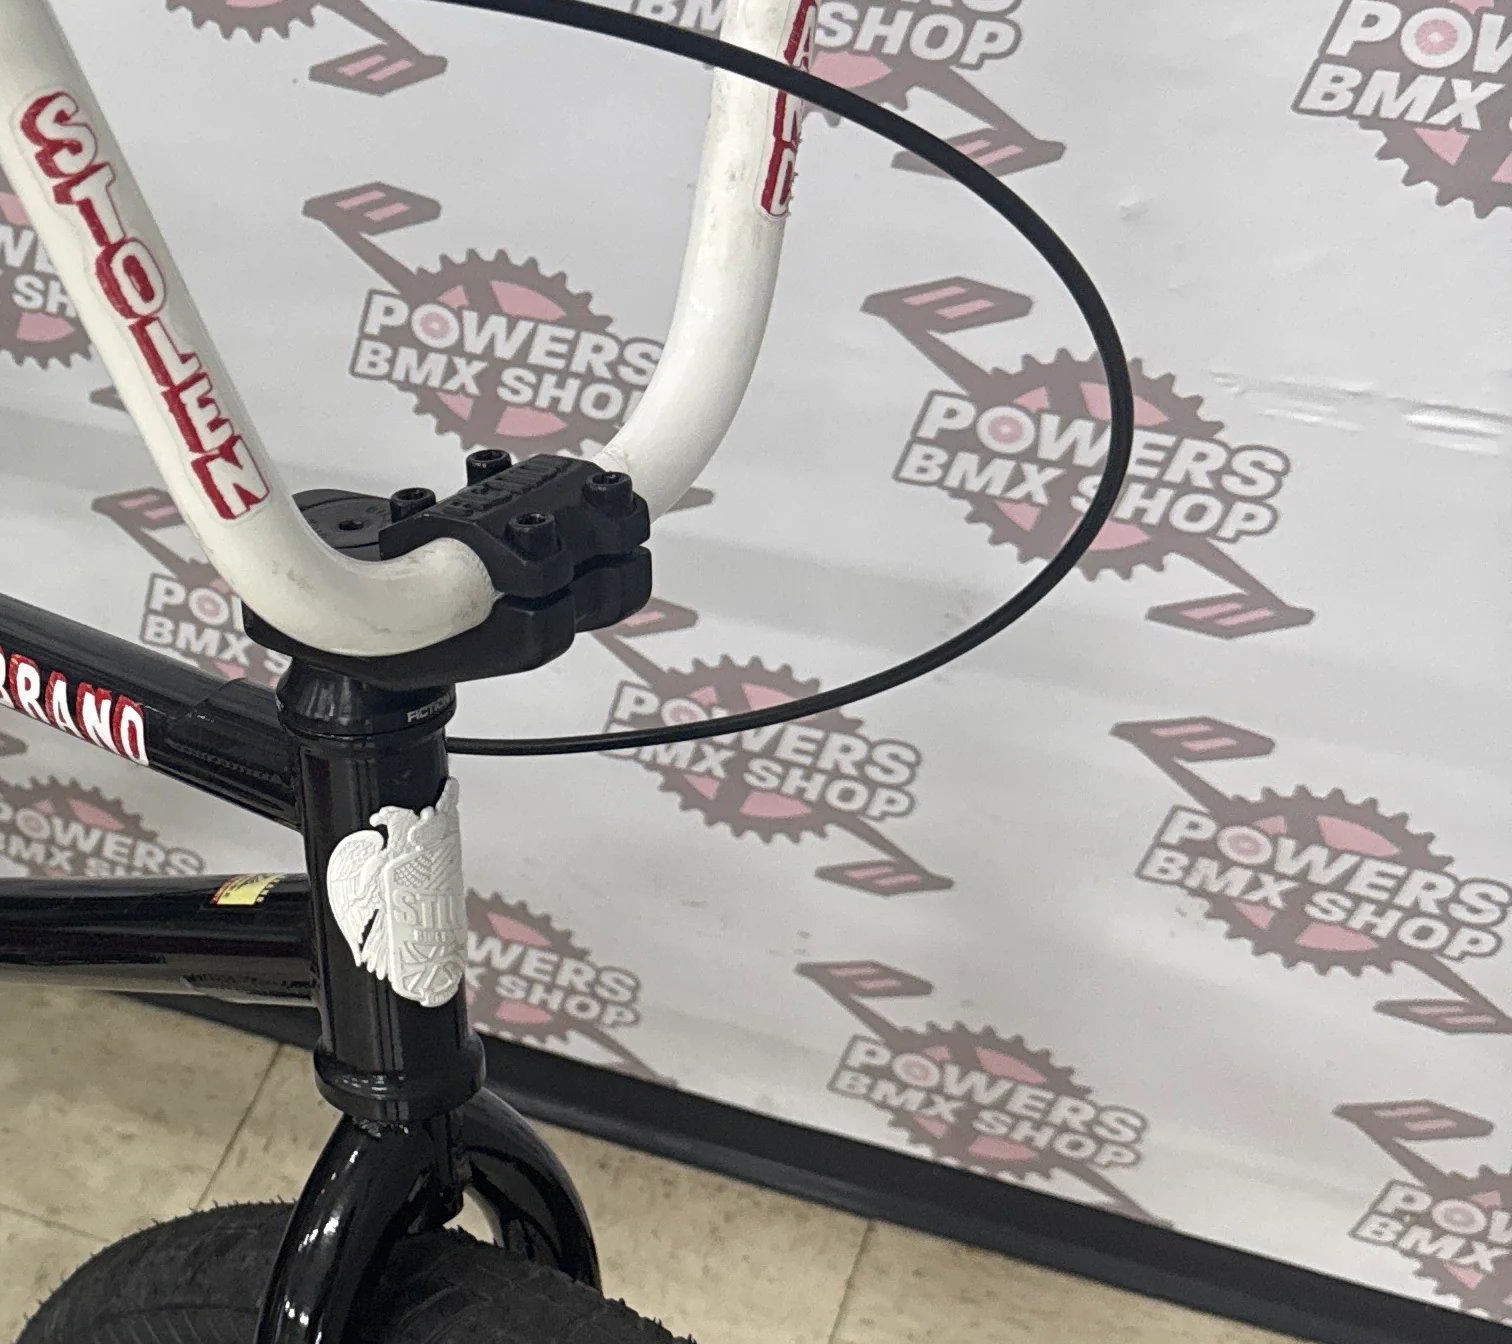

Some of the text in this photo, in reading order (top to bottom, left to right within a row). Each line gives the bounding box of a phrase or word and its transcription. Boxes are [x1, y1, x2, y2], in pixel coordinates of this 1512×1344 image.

[816, 1, 1024, 69] SHOP
[1297, 62, 1507, 132] BMX
[21, 91, 272, 521] STOLEN
[363, 293, 664, 388] POWERS
[353, 339, 644, 425] BMX SHO
[901, 446, 1061, 506] BMX
[143, 612, 254, 668] BMX
[742, 758, 912, 818] SHOP
[1141, 847, 1501, 959] BMX SHOP
[1159, 809, 1511, 926] POWERS
[467, 931, 637, 1004] WERS
[495, 974, 638, 1027] SHOP
[834, 1071, 1141, 1170] BMX SHOP
[845, 1042, 1147, 1146] POWERS
[1355, 1212, 1511, 1274] BMX
